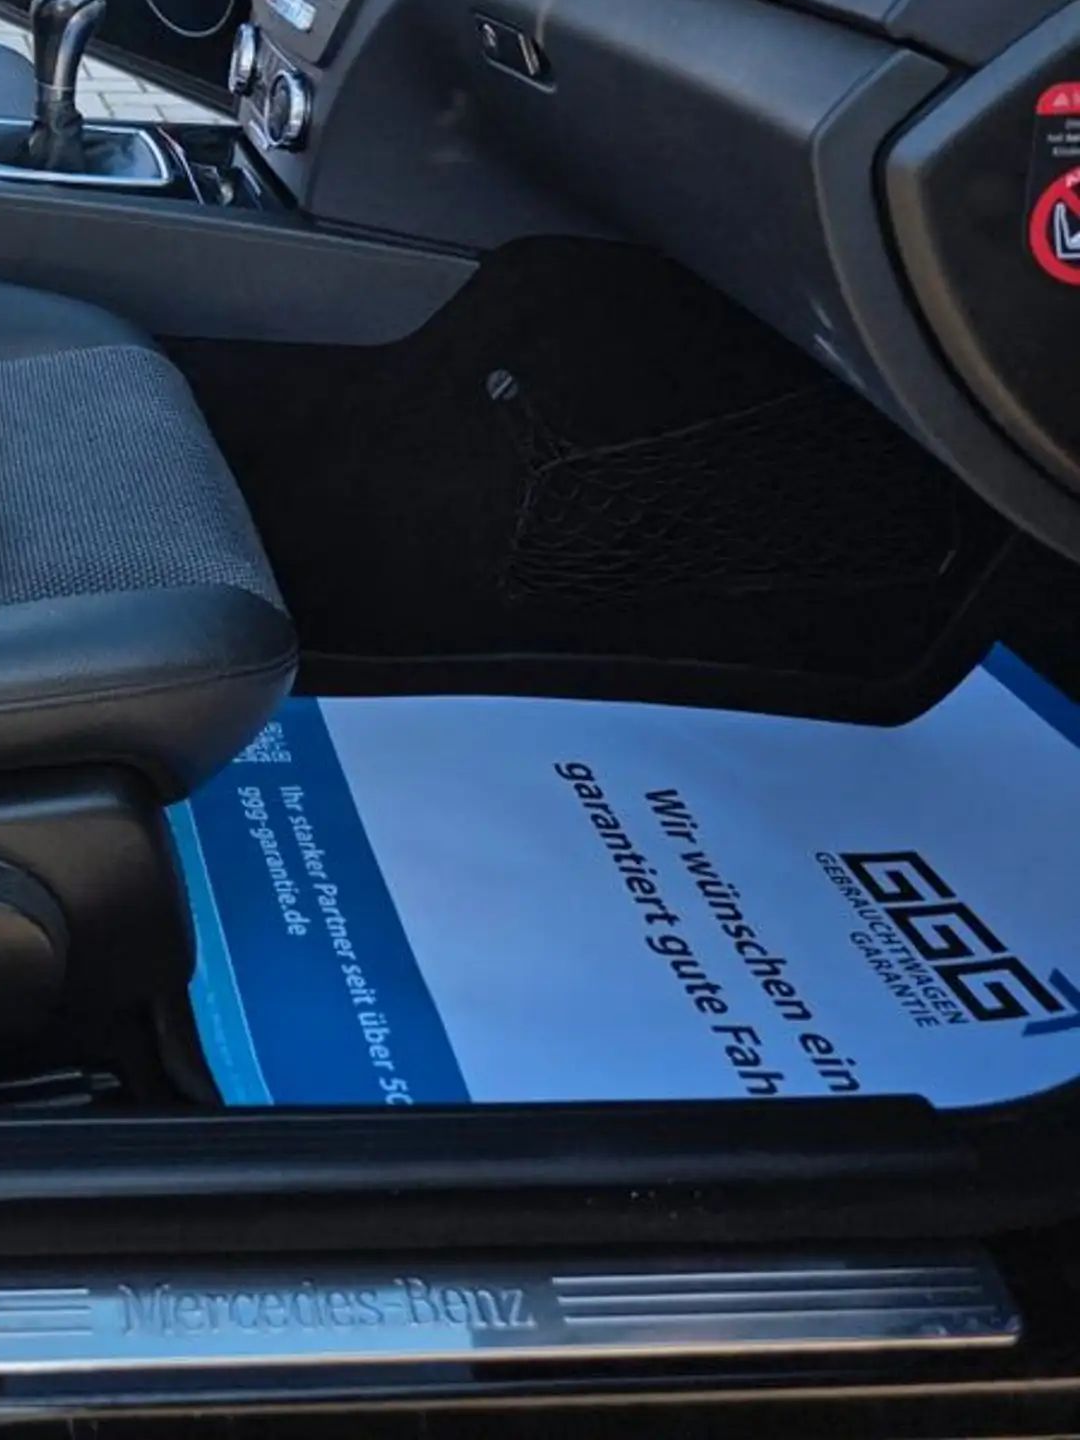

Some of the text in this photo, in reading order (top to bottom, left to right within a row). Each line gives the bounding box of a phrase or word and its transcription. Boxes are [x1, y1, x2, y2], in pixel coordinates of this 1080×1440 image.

[279, 786, 305, 812] Ihr
[237, 786, 312, 937] ggg-garantie.de
[287, 816, 329, 880] starker
[313, 883, 357, 960] Partner
[554, 762, 681, 926] garantiert
[645, 935, 729, 1016] gute
[644, 788, 699, 845] Wir
[680, 851, 812, 1021] wünschen
[814, 851, 971, 1025] GEBRAUCHTWAGEN
[340, 964, 377, 1006] seit
[849, 931, 940, 1028] GARANTIE
[357, 1012, 396, 1072] über
[117, 1277, 539, 1337] Mercedes-Benz
